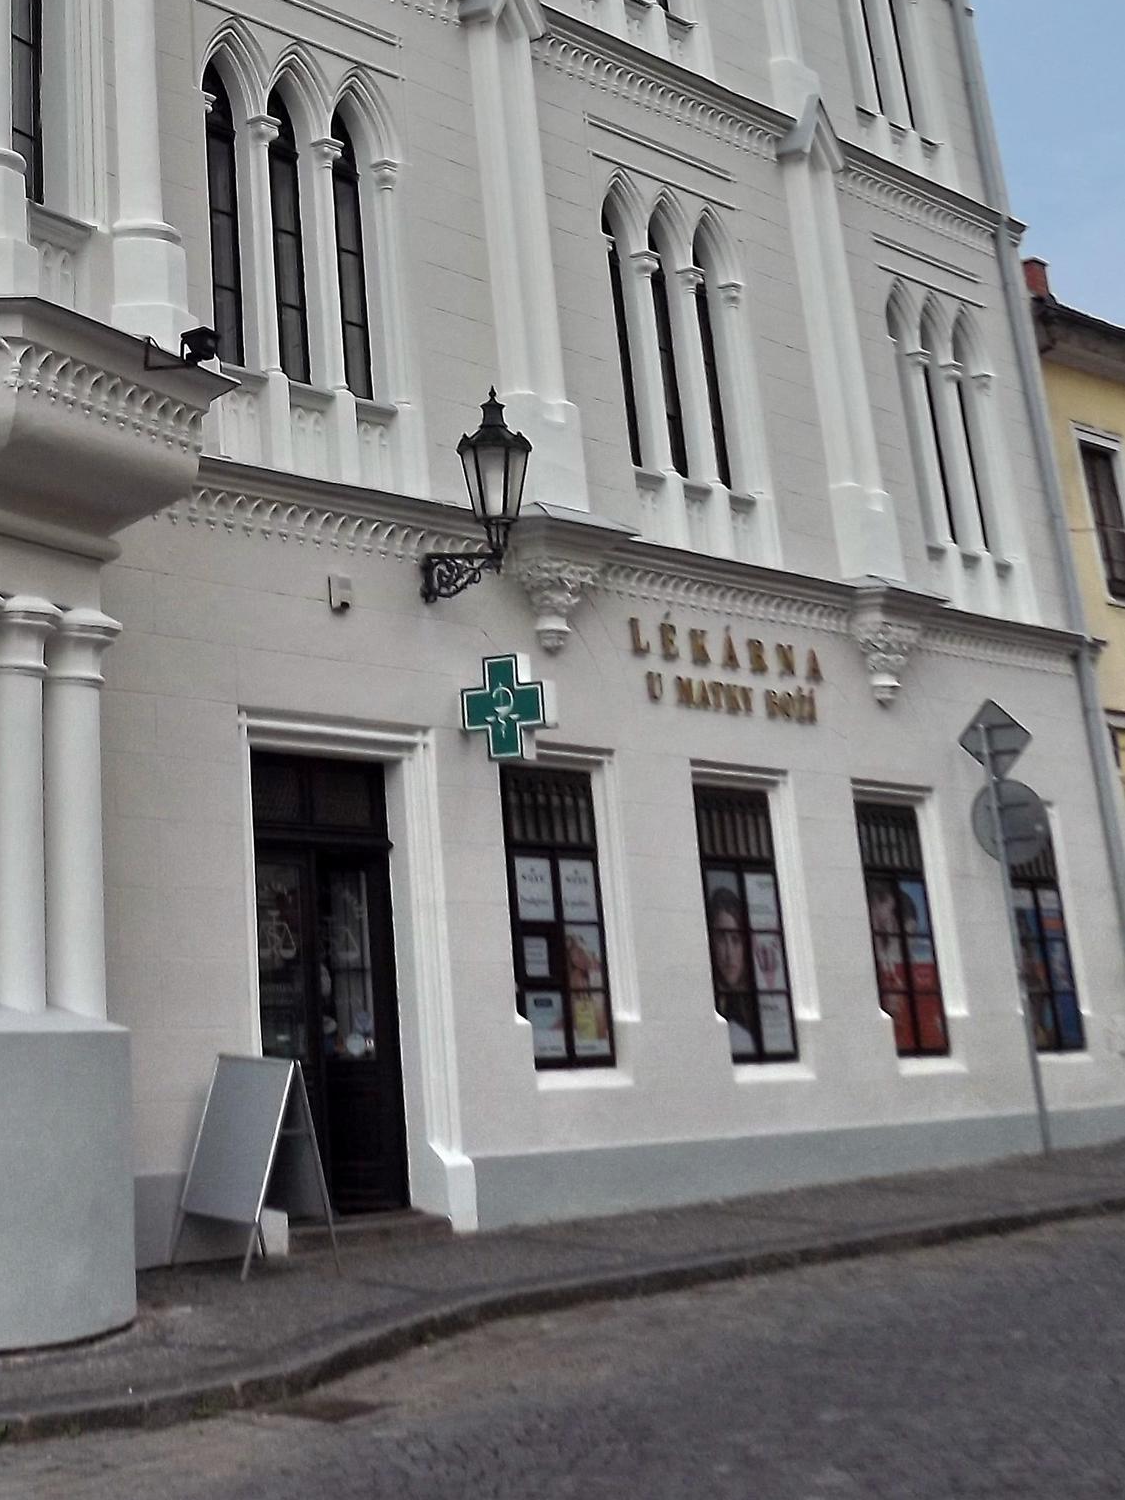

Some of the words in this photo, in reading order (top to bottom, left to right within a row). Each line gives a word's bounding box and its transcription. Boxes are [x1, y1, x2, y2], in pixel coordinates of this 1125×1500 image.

[628, 611, 824, 684] LÉKÁRNA
[646, 671, 664, 703] U
[675, 676, 753, 715] MATKY
[764, 686, 818, 726] BOŽÍ
